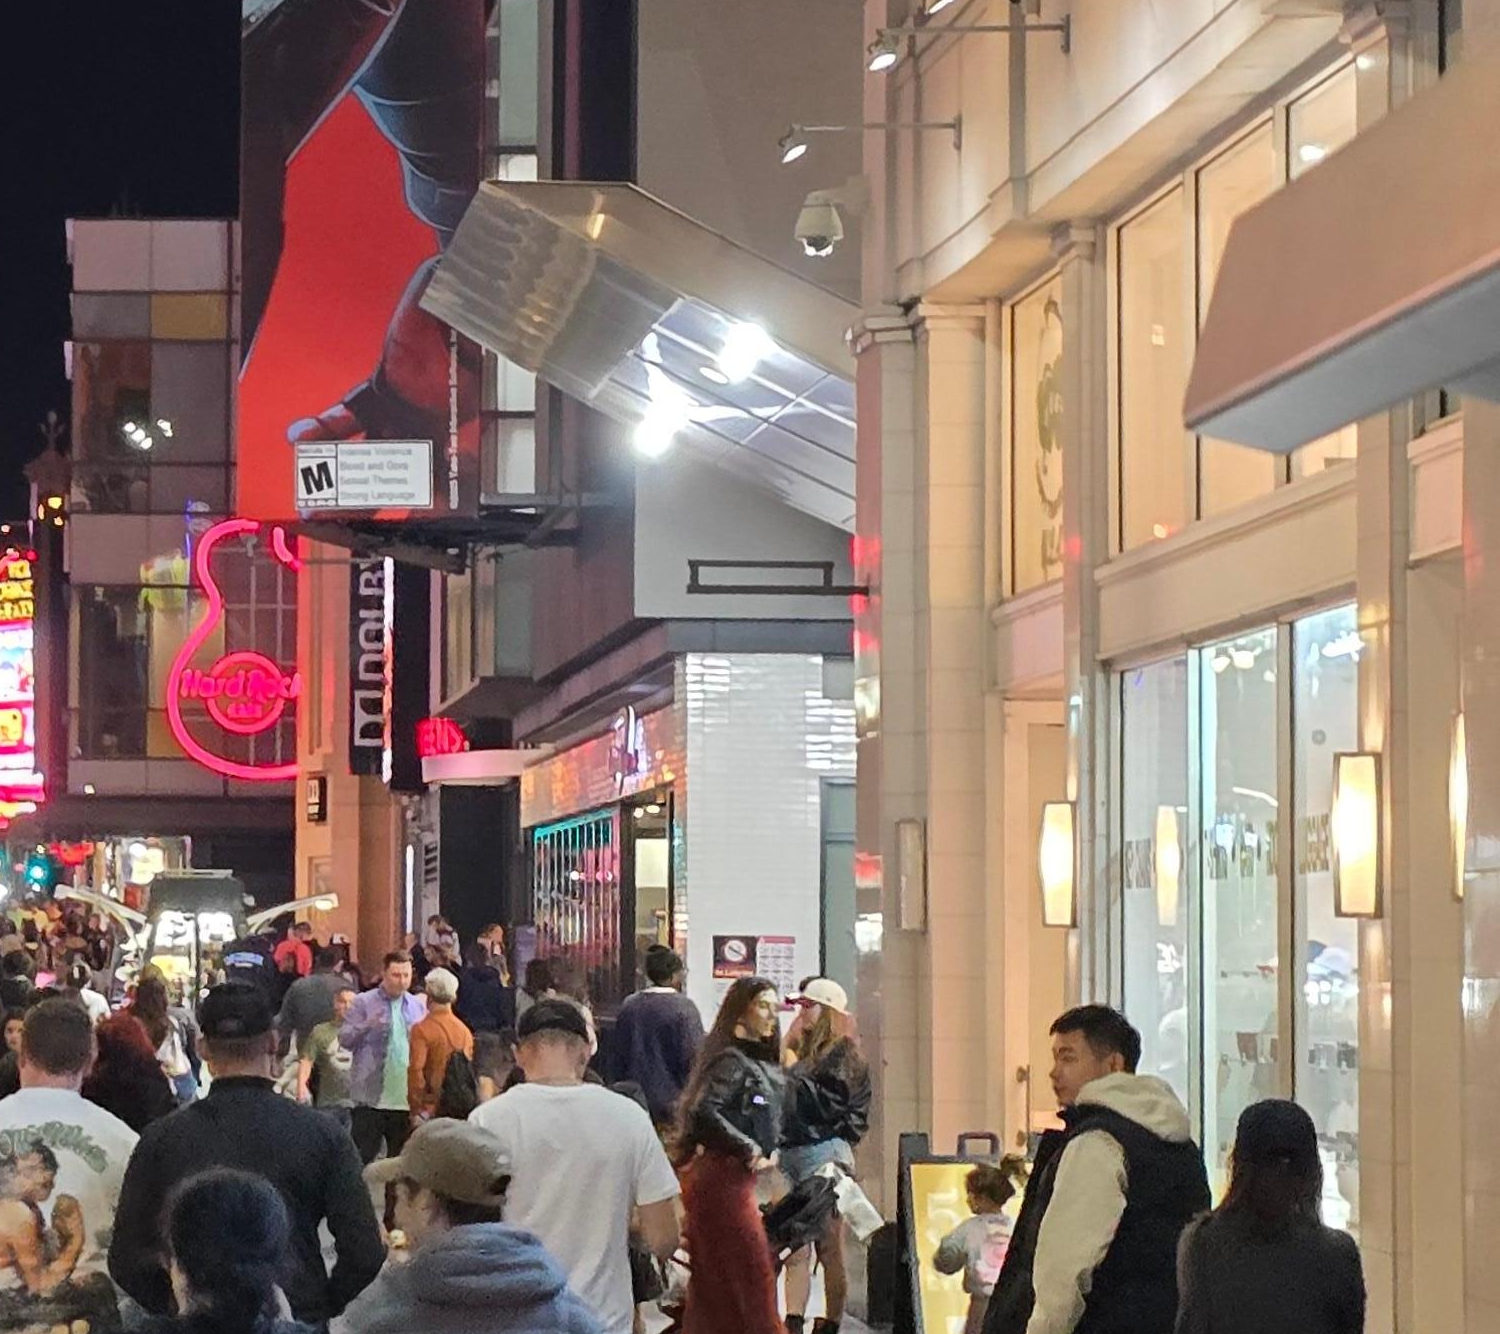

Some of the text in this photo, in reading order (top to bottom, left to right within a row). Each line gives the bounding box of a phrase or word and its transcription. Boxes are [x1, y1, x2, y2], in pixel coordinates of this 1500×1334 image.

[300, 460, 334, 496] M
[368, 461, 384, 471] and
[180, 668, 245, 698] Hard
